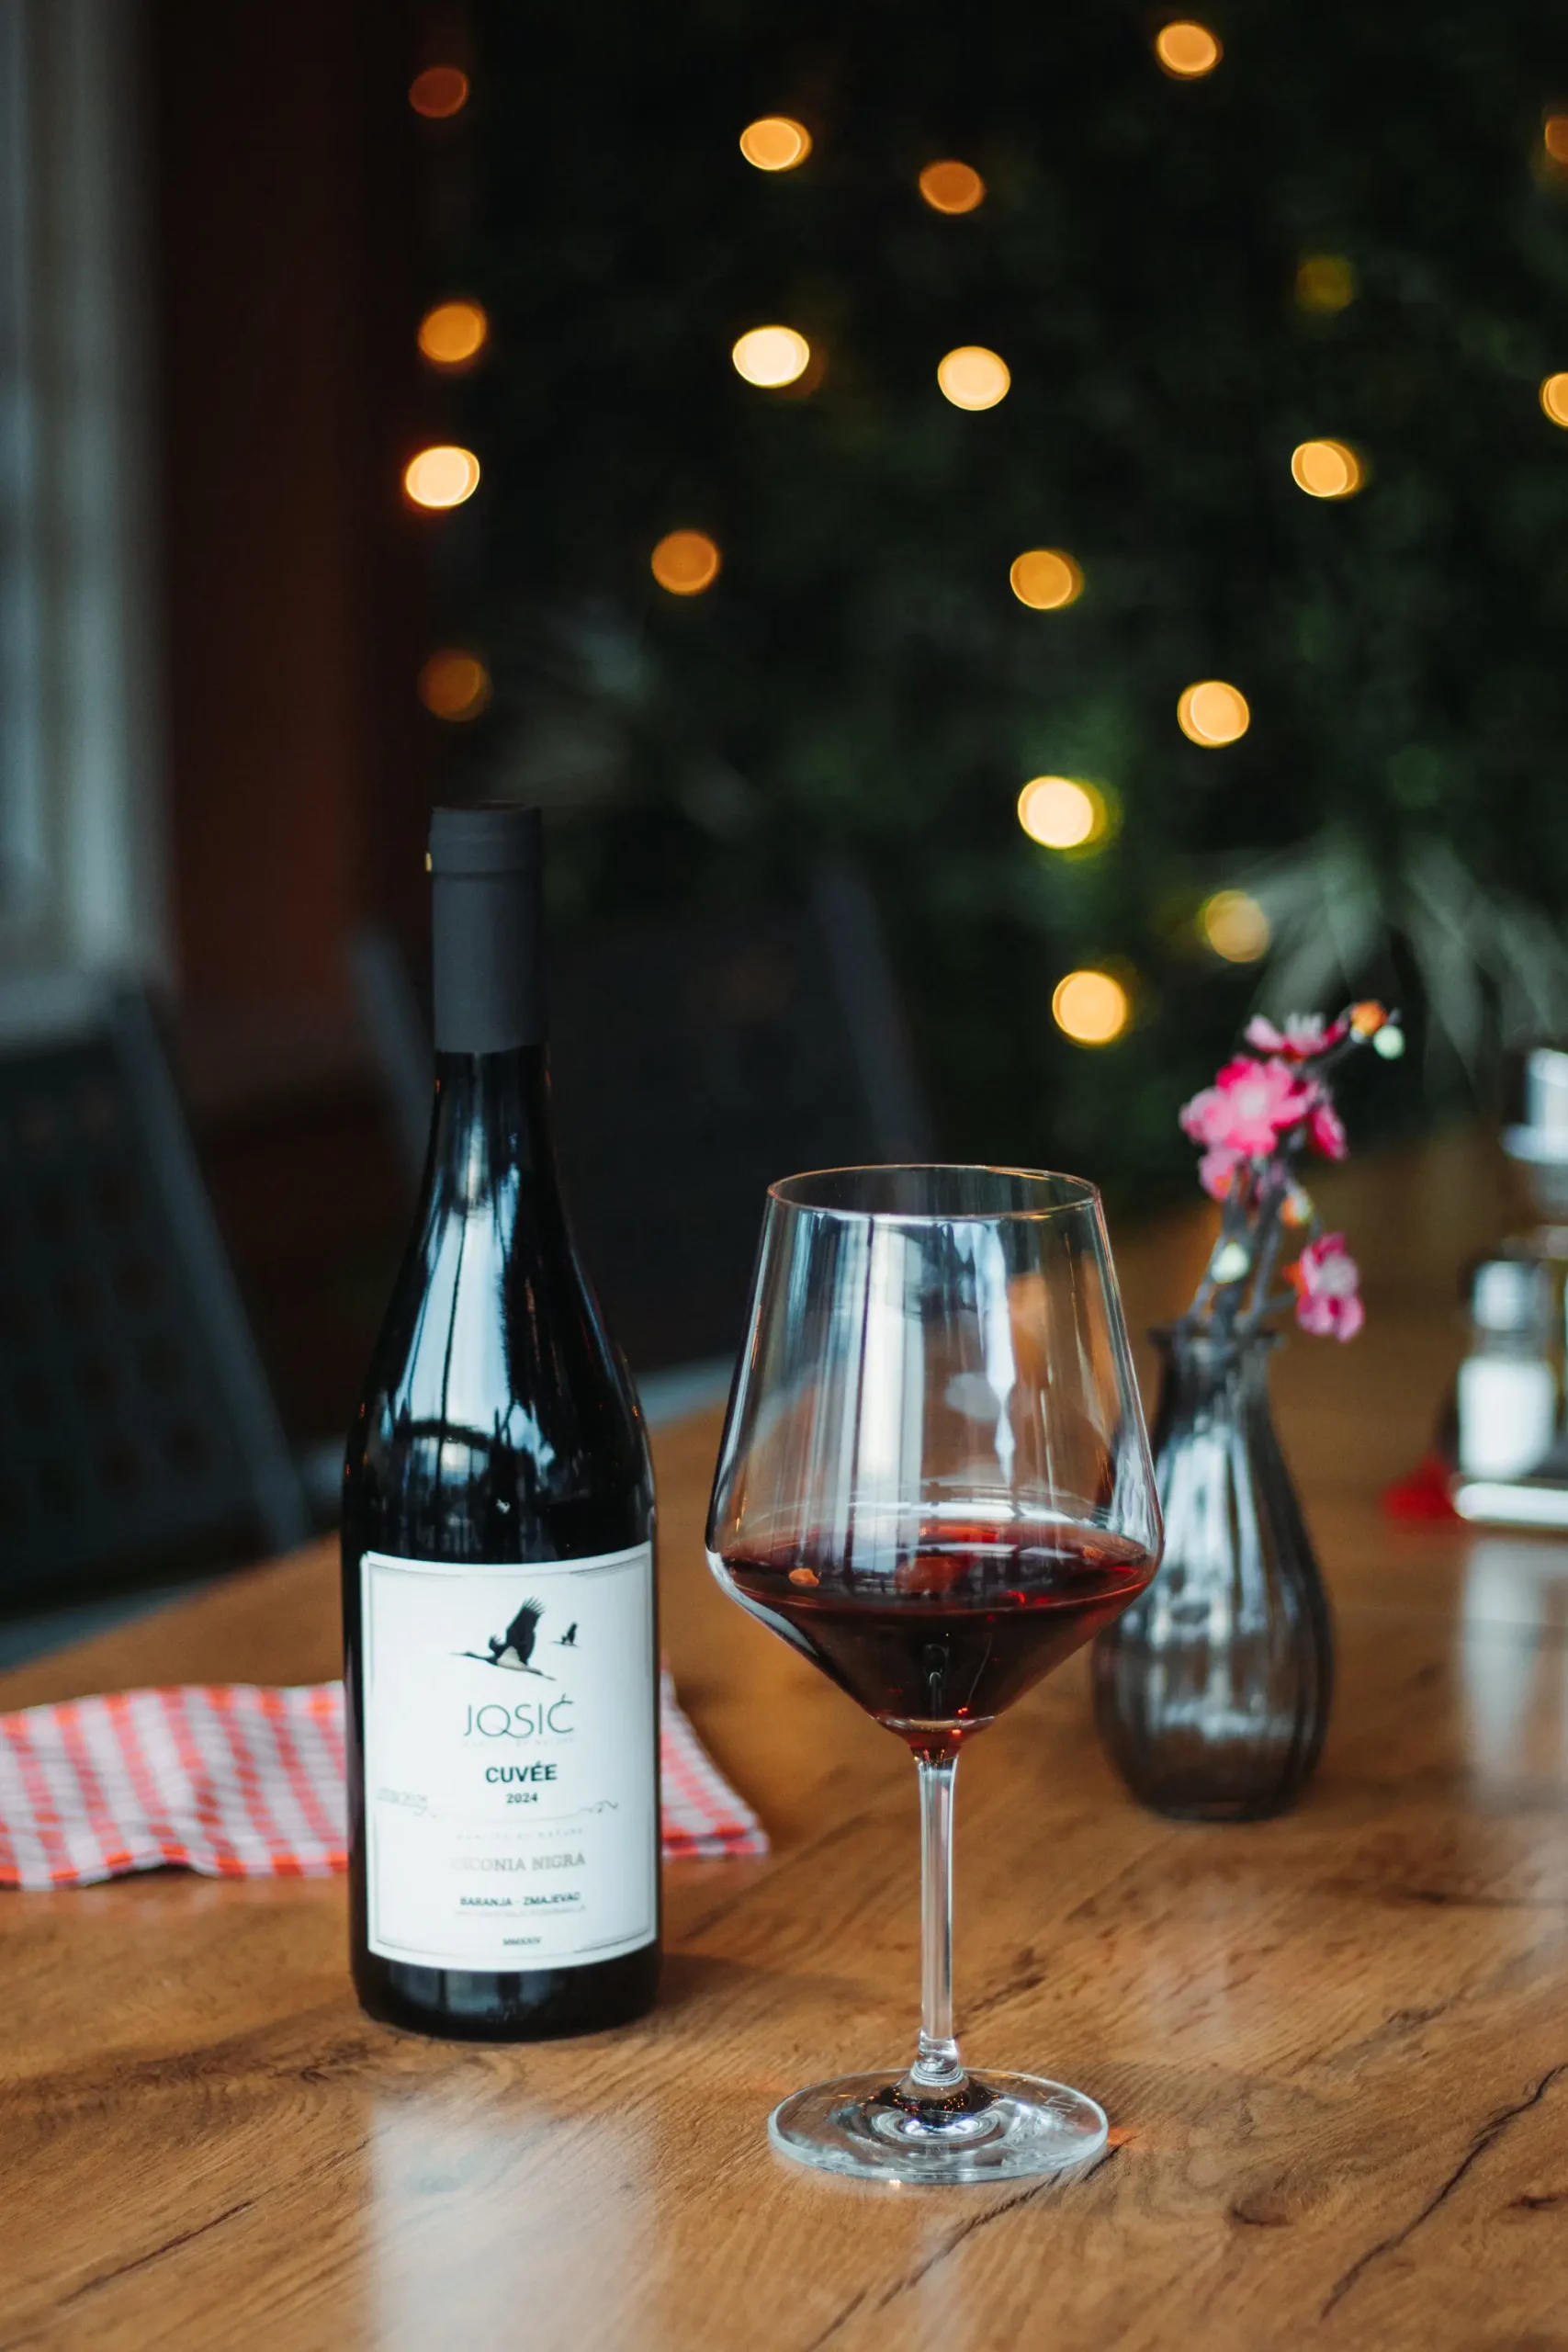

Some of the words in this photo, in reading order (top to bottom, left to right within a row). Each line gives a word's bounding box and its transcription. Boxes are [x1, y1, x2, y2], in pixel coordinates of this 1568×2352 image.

[486, 1760, 558, 1783] CUVÉE
[506, 1792, 538, 1804] 2024
[532, 1852, 585, 1871] NIGRA
[460, 1896, 513, 1906] BARANJA
